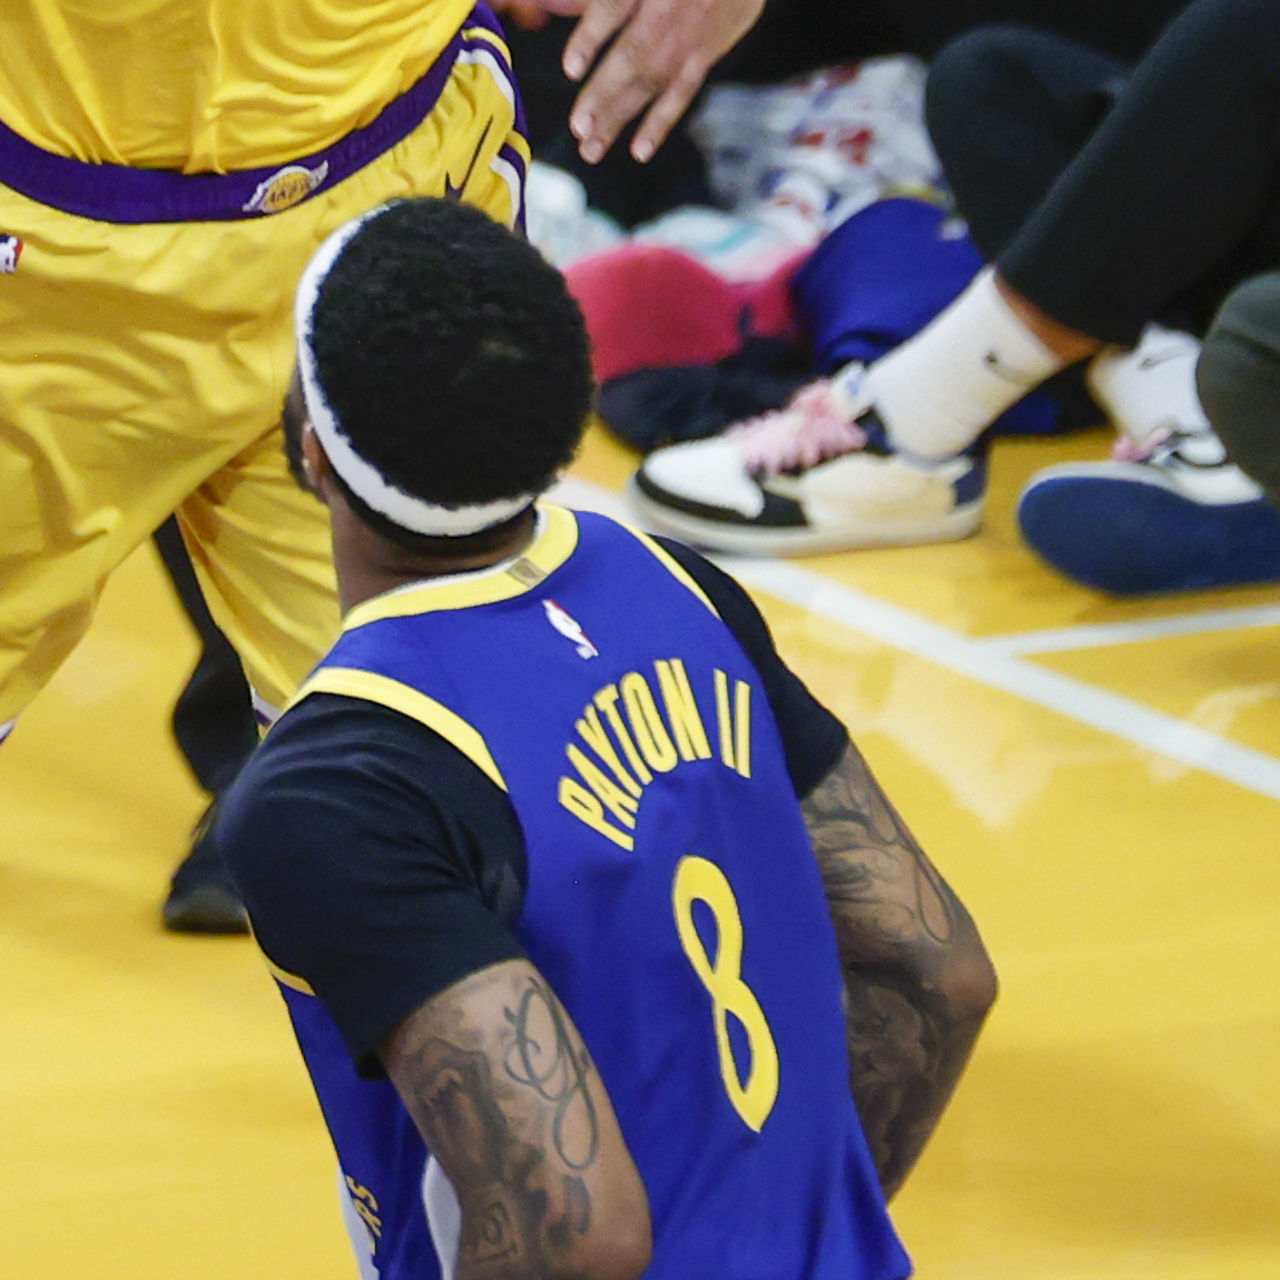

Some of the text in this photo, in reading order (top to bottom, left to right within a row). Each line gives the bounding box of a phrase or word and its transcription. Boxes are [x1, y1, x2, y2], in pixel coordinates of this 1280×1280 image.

[558, 657, 752, 853] PAYTON II
[672, 854, 780, 1133] 8
